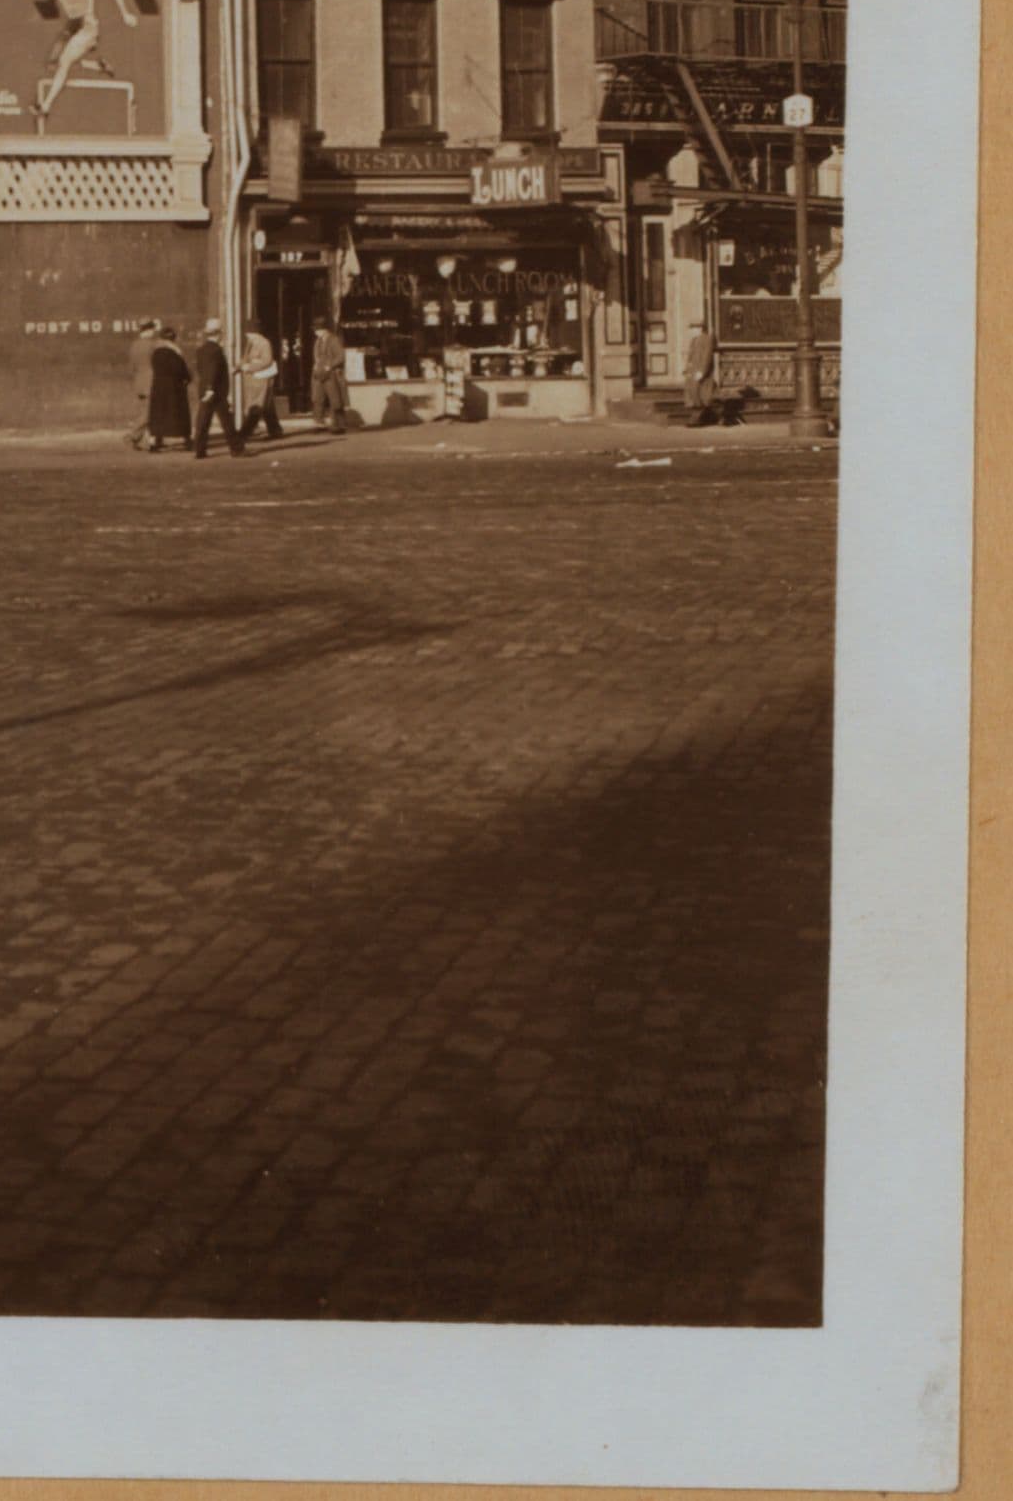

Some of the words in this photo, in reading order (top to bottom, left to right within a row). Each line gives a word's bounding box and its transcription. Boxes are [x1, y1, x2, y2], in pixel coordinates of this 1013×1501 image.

[470, 165, 546, 205] LUNCH
[25, 321, 71, 335] POST
[78, 320, 103, 333] NO
